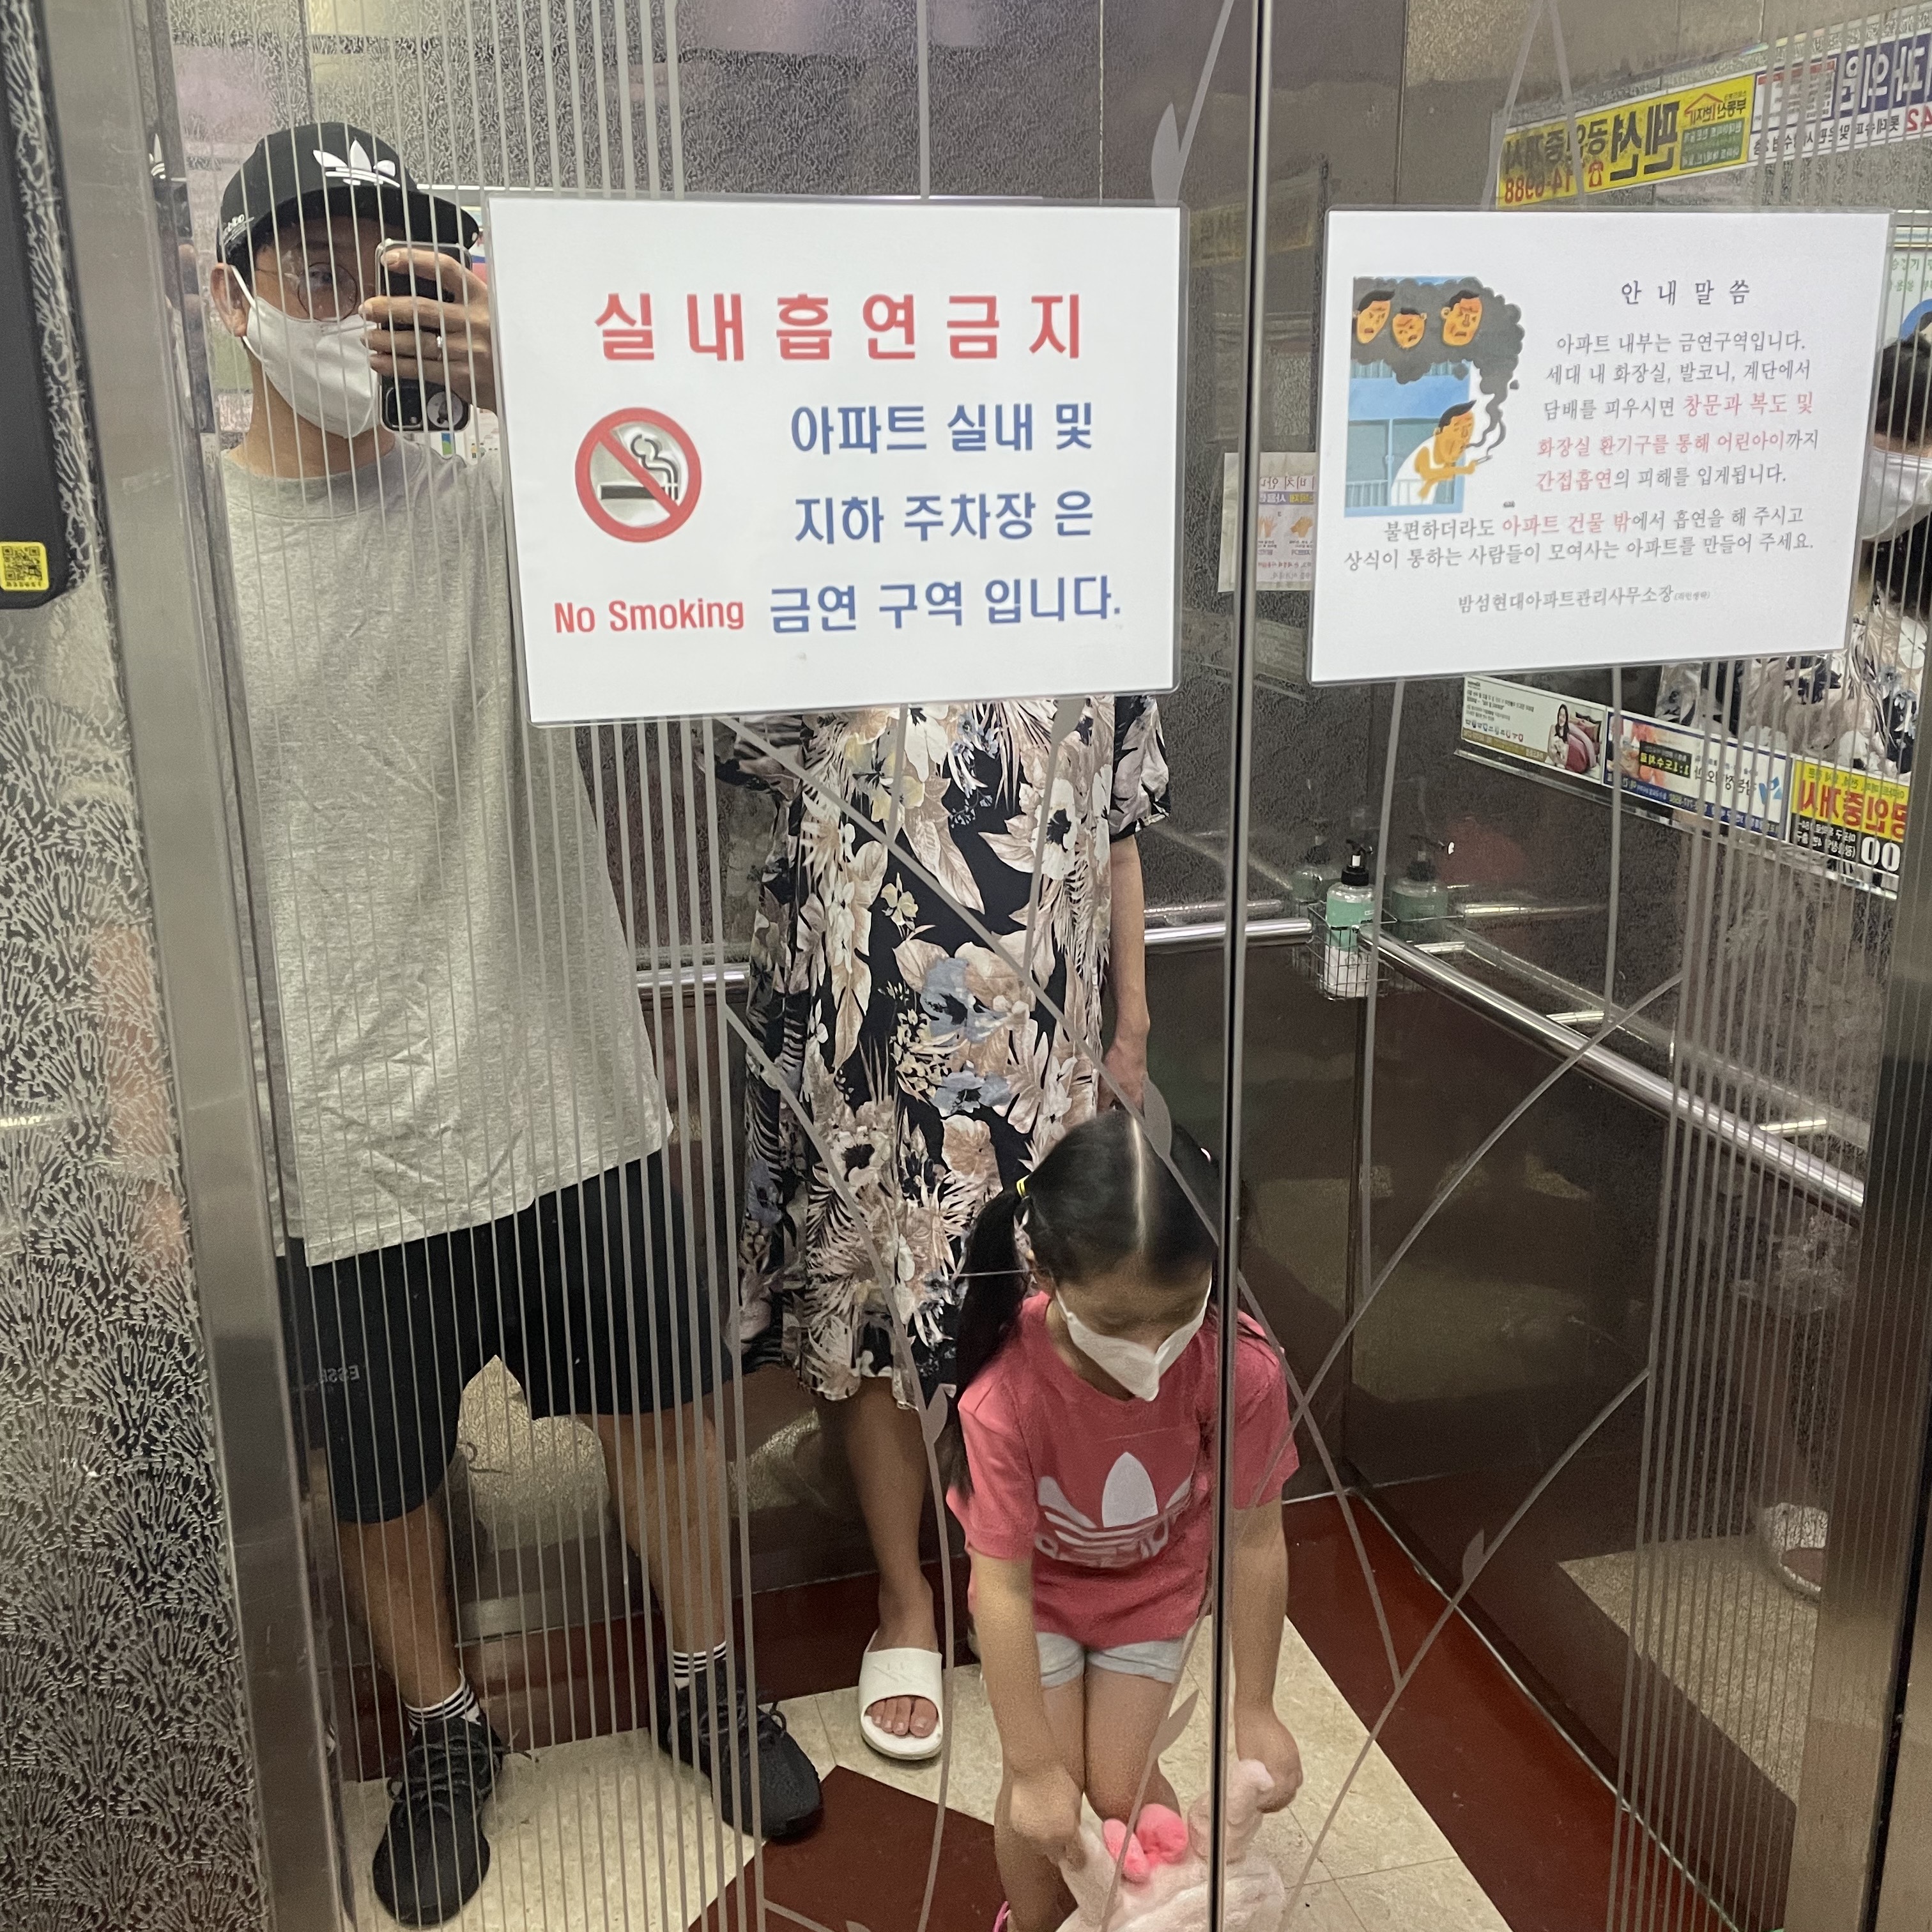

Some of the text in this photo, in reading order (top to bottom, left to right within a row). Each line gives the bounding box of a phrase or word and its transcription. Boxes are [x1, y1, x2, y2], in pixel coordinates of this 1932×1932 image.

[1558, 330, 1805, 355] 아파트 내부는 금연구역입니다.
[1546, 359, 1809, 385] 세대 내 화장실, 발코니, 계단에서
[1544, 392, 1813, 420] 담배를 피우시면 창문과 복도 및
[792, 402, 1091, 455] 아파트 실내 및
[1538, 429, 1818, 457] 화장실 환기구를 통해 어린아이까지
[1537, 463, 1786, 491] 간접흡연의 피해를 입게됩니다.
[795, 491, 1092, 544] 지하 주차장 은
[1384, 505, 1803, 542] 불편하더라도 아파트 건물 밖에서 흡연을 해 주시고
[1344, 532, 1813, 571] 상식이 통하는 사람들이 모여사는 아파트를 만들어 주세요.
[555, 598, 744, 632] No Smoking
[770, 575, 1120, 633] 금연 구역 입니다.
